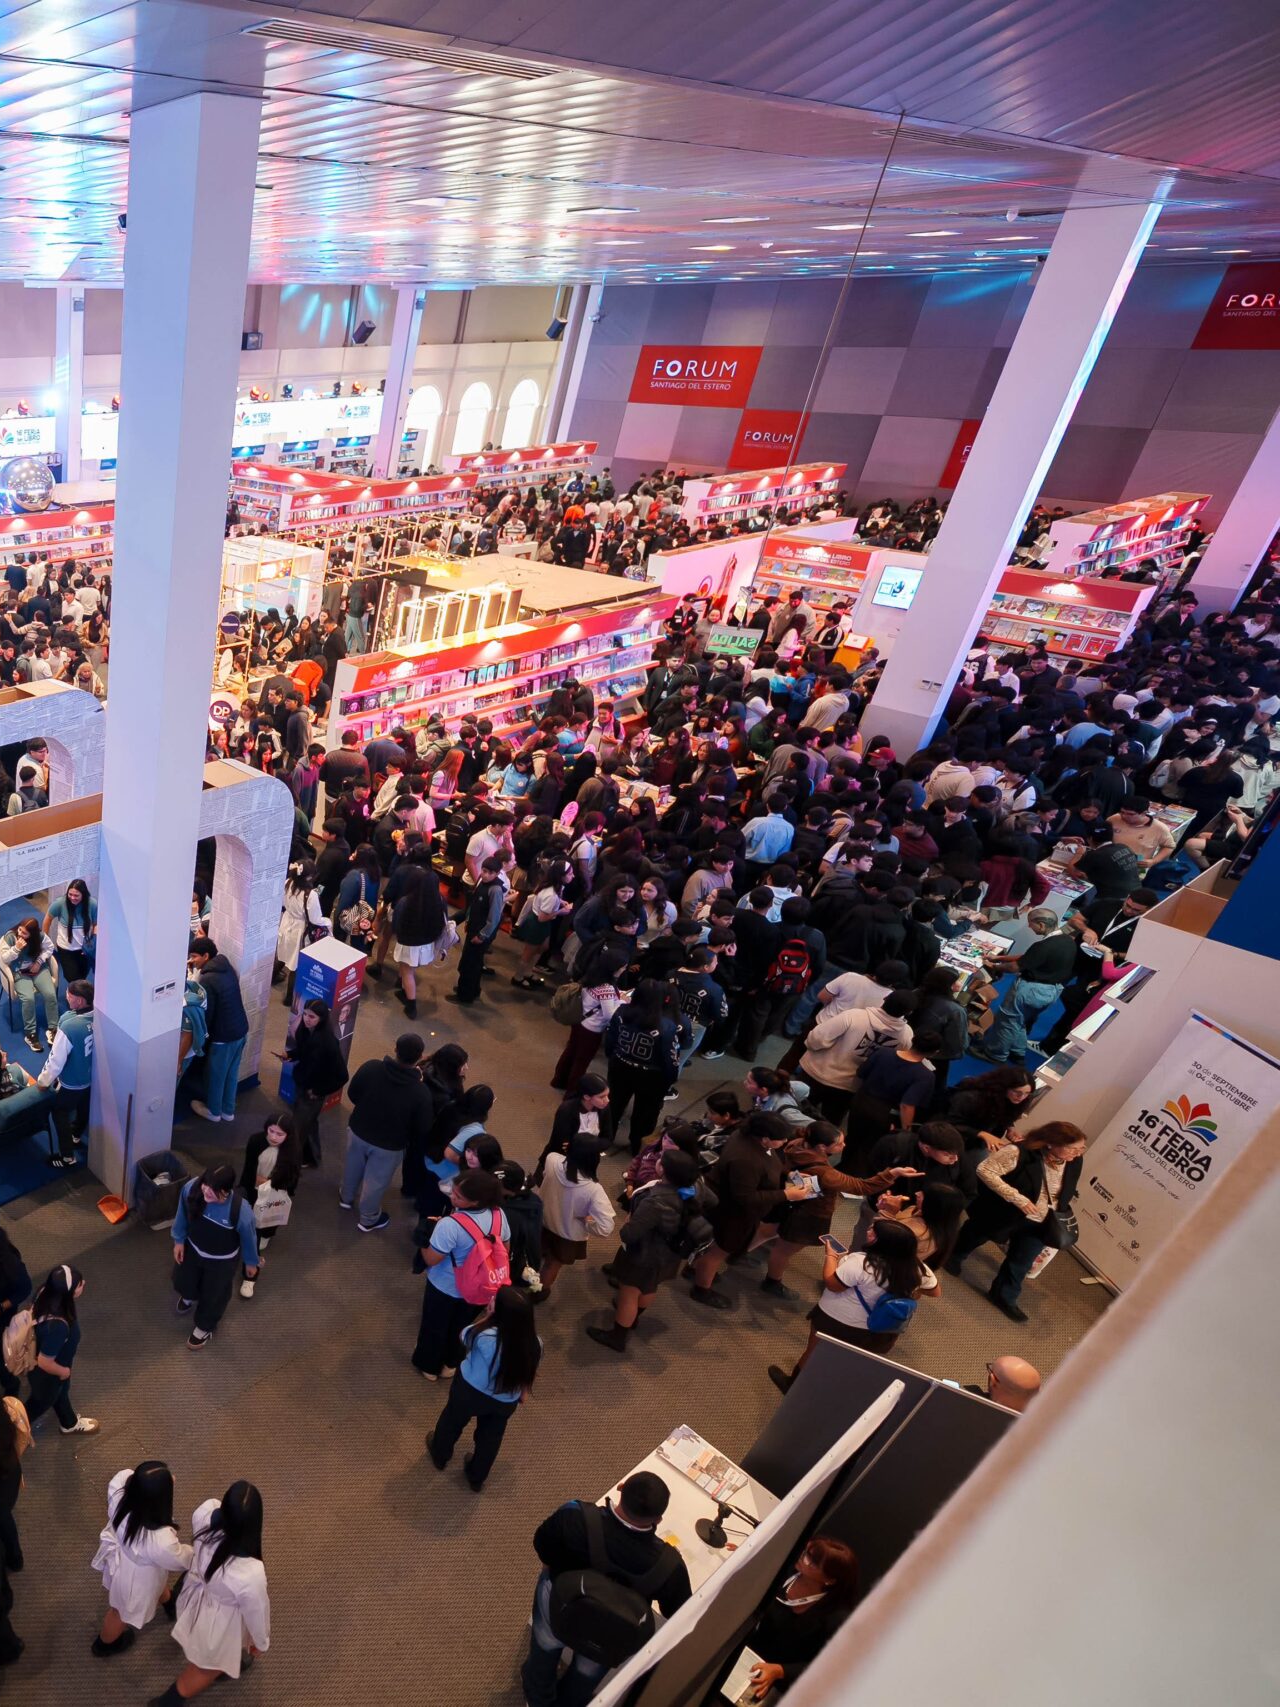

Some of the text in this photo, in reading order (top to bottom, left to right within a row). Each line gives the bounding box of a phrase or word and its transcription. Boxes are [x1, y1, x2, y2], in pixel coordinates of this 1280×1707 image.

[1226, 293, 1280, 308] FOR
[652, 359, 738, 379] FORUM
[650, 381, 732, 391] SANTIAGO DEL ESTERO
[23, 428, 41, 436] FERIA
[744, 431, 793, 443] FORUM
[213, 705, 231, 716] DP
[618, 1024, 655, 1061] 26
[1191, 1060, 1258, 1107] 30 de SEPTIEMBRE
[1195, 1072, 1206, 1082] 04
[1205, 1079, 1215, 1088] de
[1215, 1085, 1252, 1113] OCTUBRE
[1122, 1131, 1196, 1190] SANTIAGO DEL ESTERO
[1128, 1124, 1205, 1182] del LIBRO
[1157, 1124, 1212, 1173] FERIA
